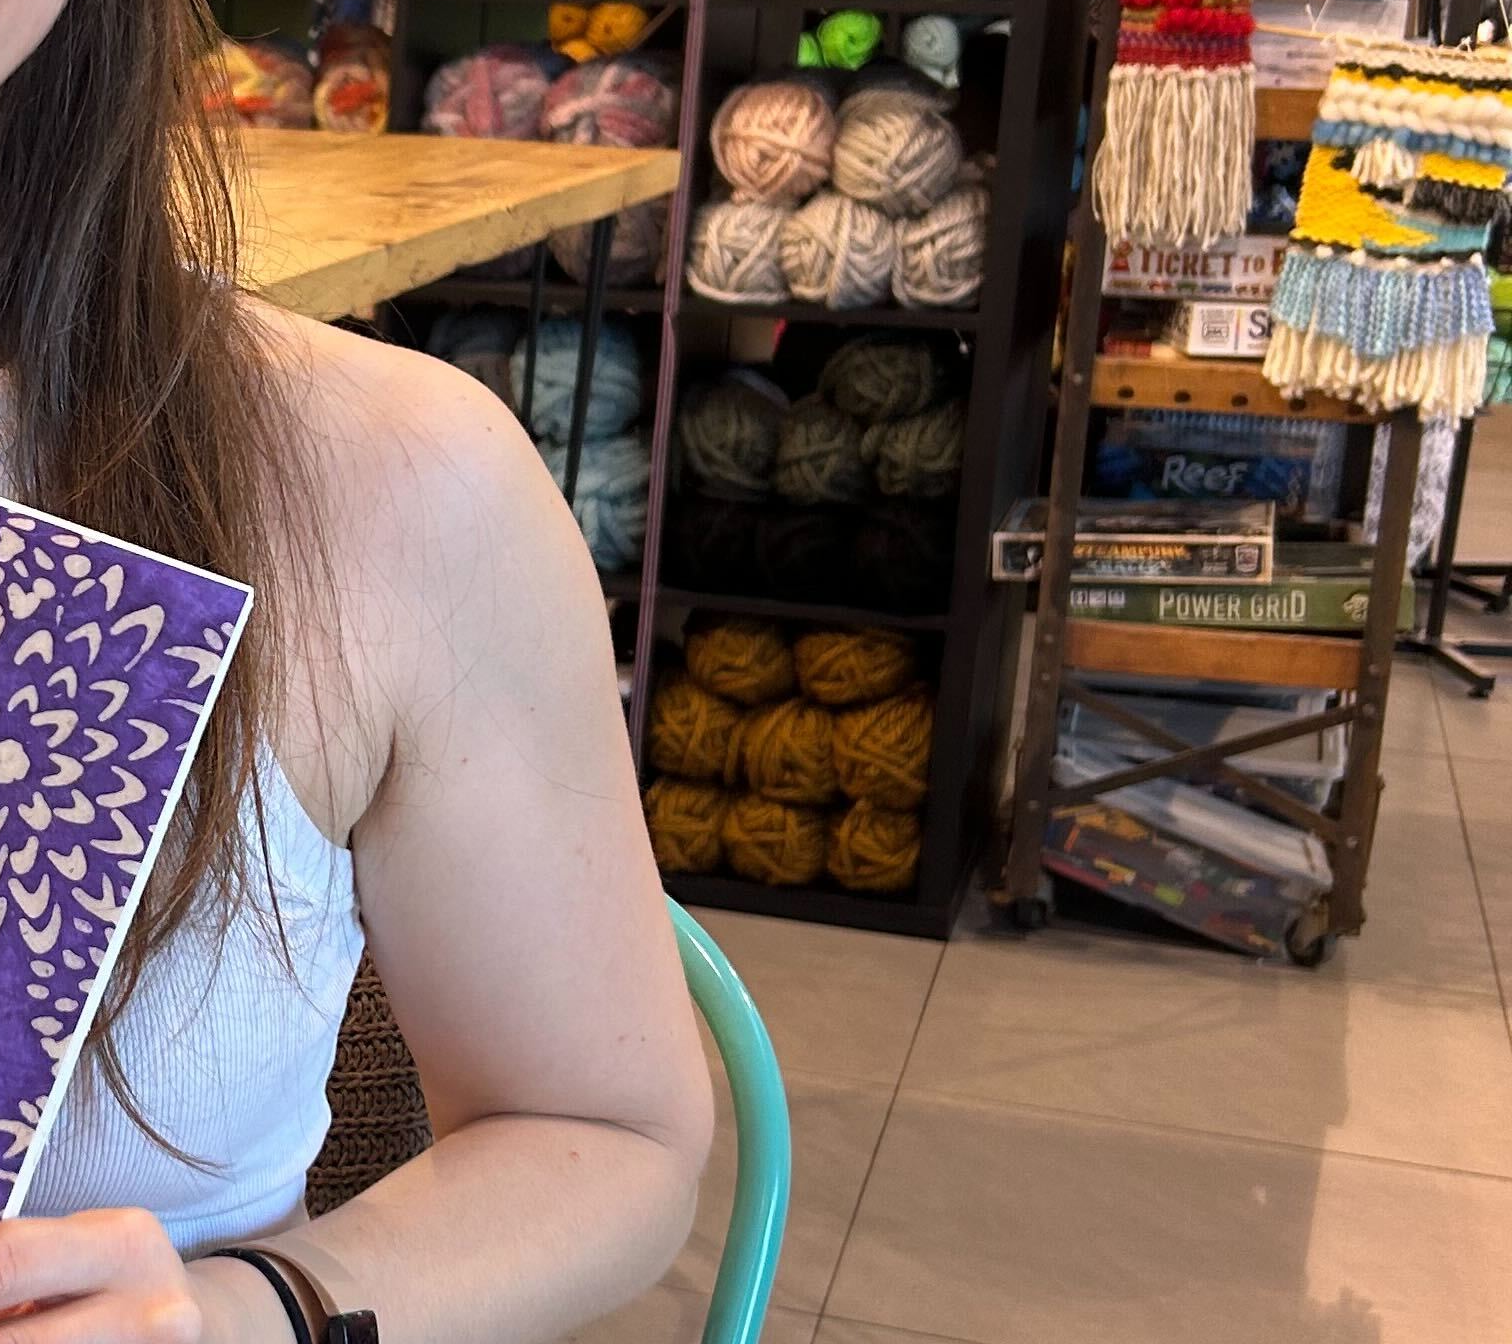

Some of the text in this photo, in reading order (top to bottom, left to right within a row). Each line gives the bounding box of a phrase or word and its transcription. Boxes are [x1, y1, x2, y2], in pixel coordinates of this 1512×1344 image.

[1141, 247, 1236, 277] TICKET
[1161, 454, 1249, 494] Reef
[1159, 589, 1240, 620] POWER
[1250, 589, 1307, 622] GRID
